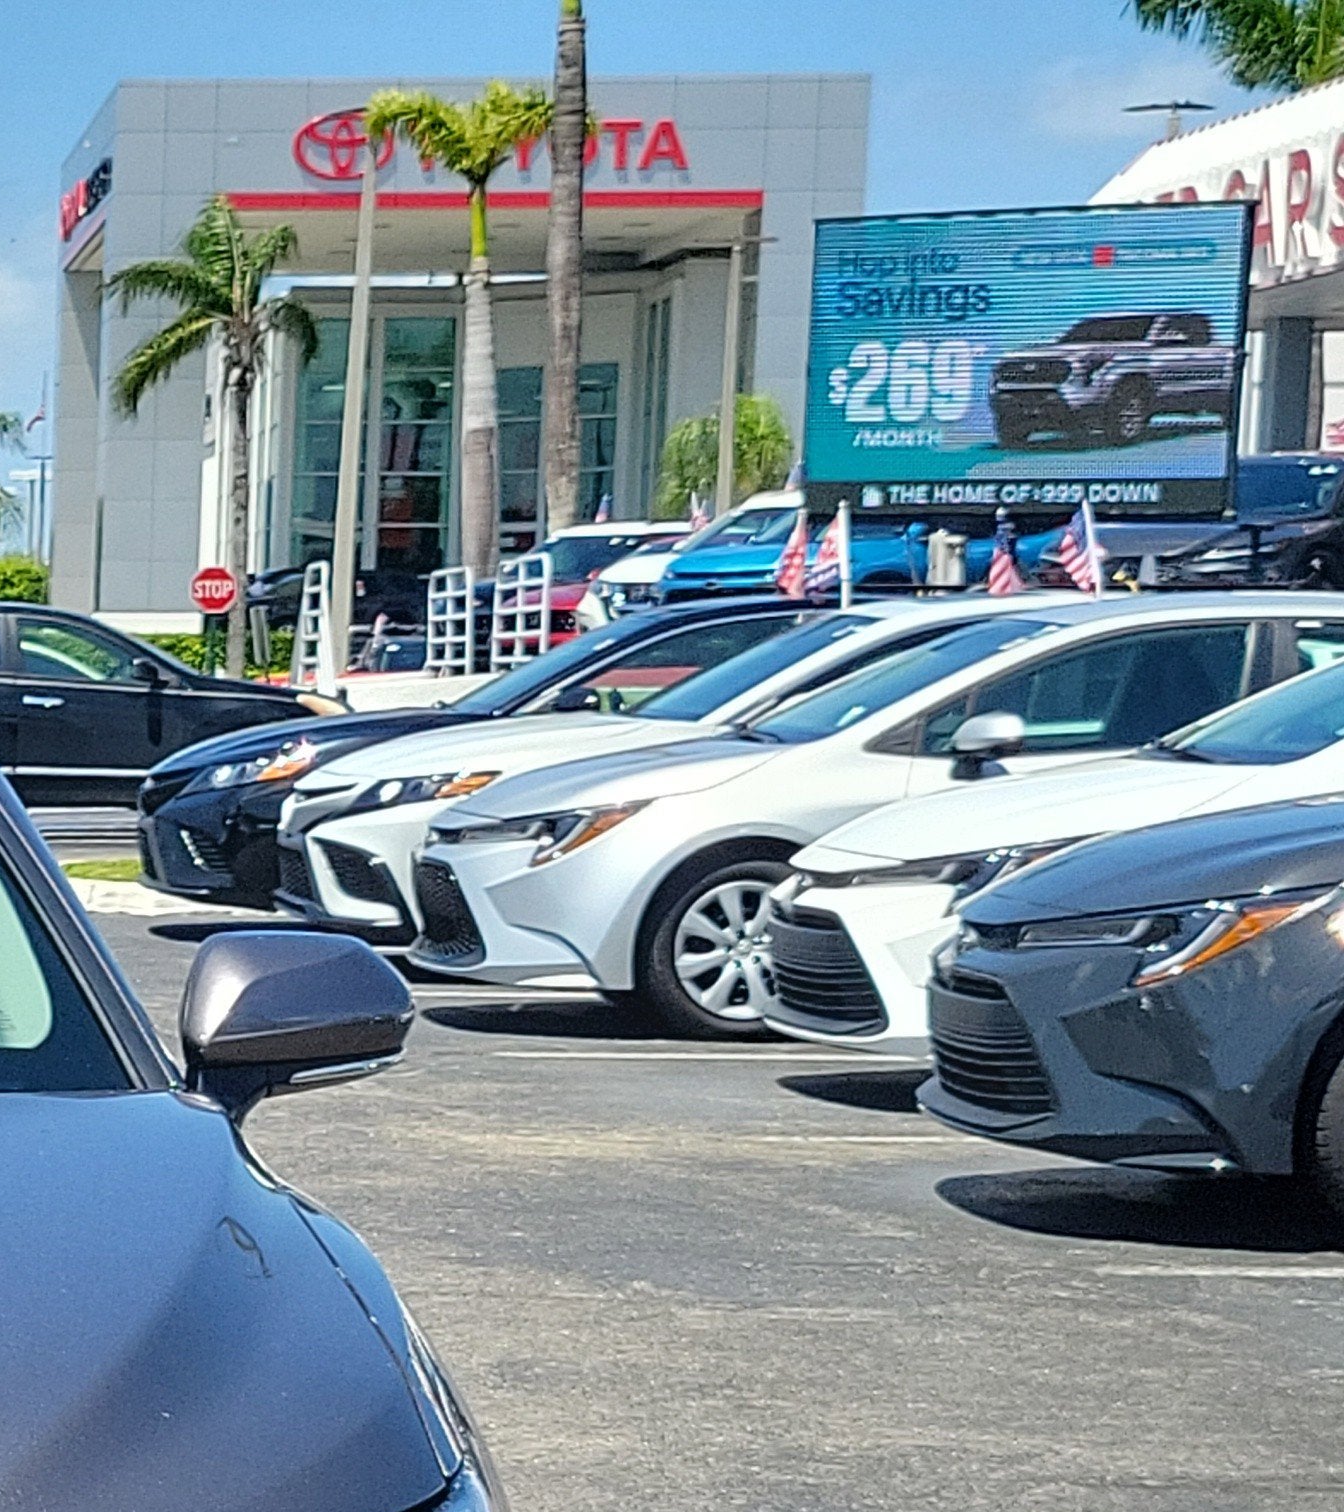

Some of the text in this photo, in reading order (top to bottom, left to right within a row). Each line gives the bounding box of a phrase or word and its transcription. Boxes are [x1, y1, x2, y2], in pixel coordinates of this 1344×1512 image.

[408, 119, 688, 172] YTA
[837, 281, 992, 321] Savings
[828, 341, 974, 422] $269
[888, 482, 929, 504] THE
[933, 482, 997, 504] HOME
[999, 483, 1031, 503] OF
[1089, 483, 1159, 503] DOWN
[194, 580, 233, 598] STOP
